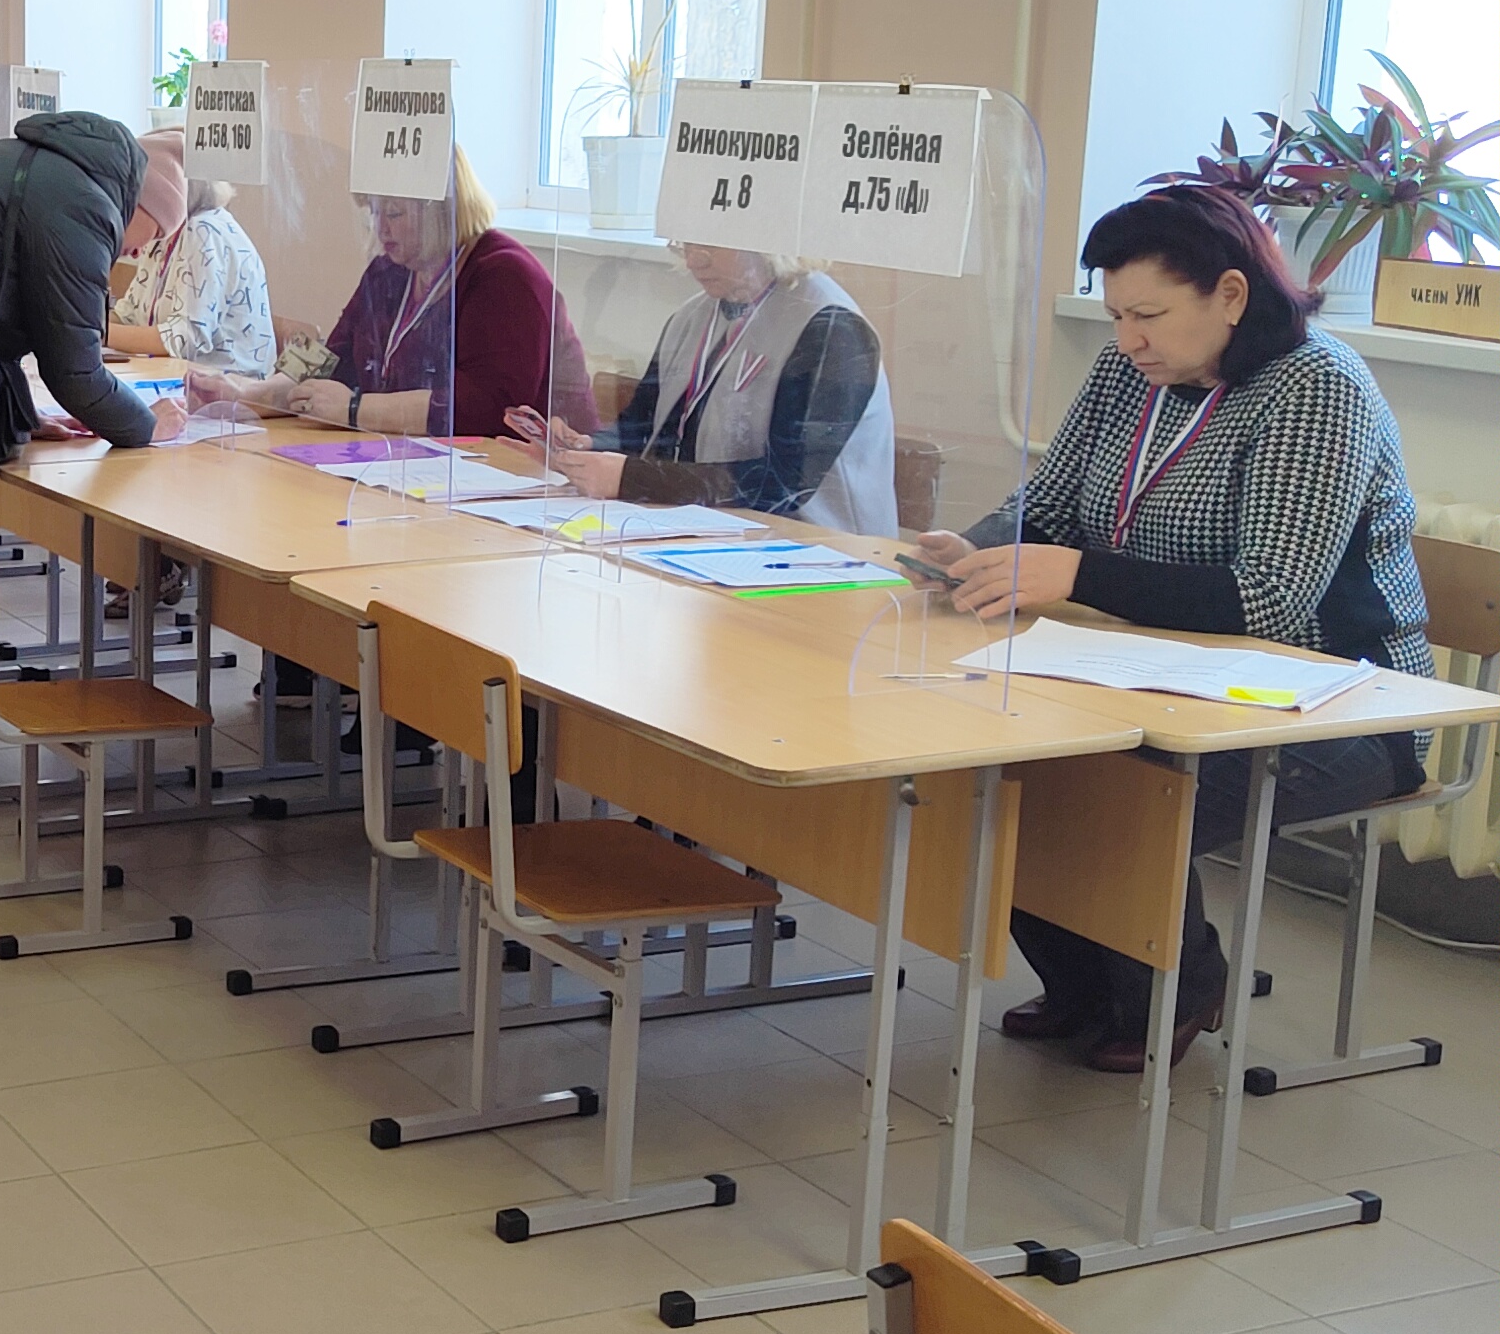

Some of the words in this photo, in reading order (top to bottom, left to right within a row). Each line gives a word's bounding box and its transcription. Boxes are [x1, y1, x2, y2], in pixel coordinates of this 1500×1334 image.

[195, 85, 255, 113] Советская
[364, 86, 445, 117] Винокурова
[412, 127, 421, 156] 6
[676, 121, 799, 162] Винокурова
[842, 122, 942, 164] Зелёная
[710, 177, 732, 212] д.
[737, 174, 753, 208] 8
[841, 176, 890, 215] д.75
[1455, 283, 1482, 307] УИК
